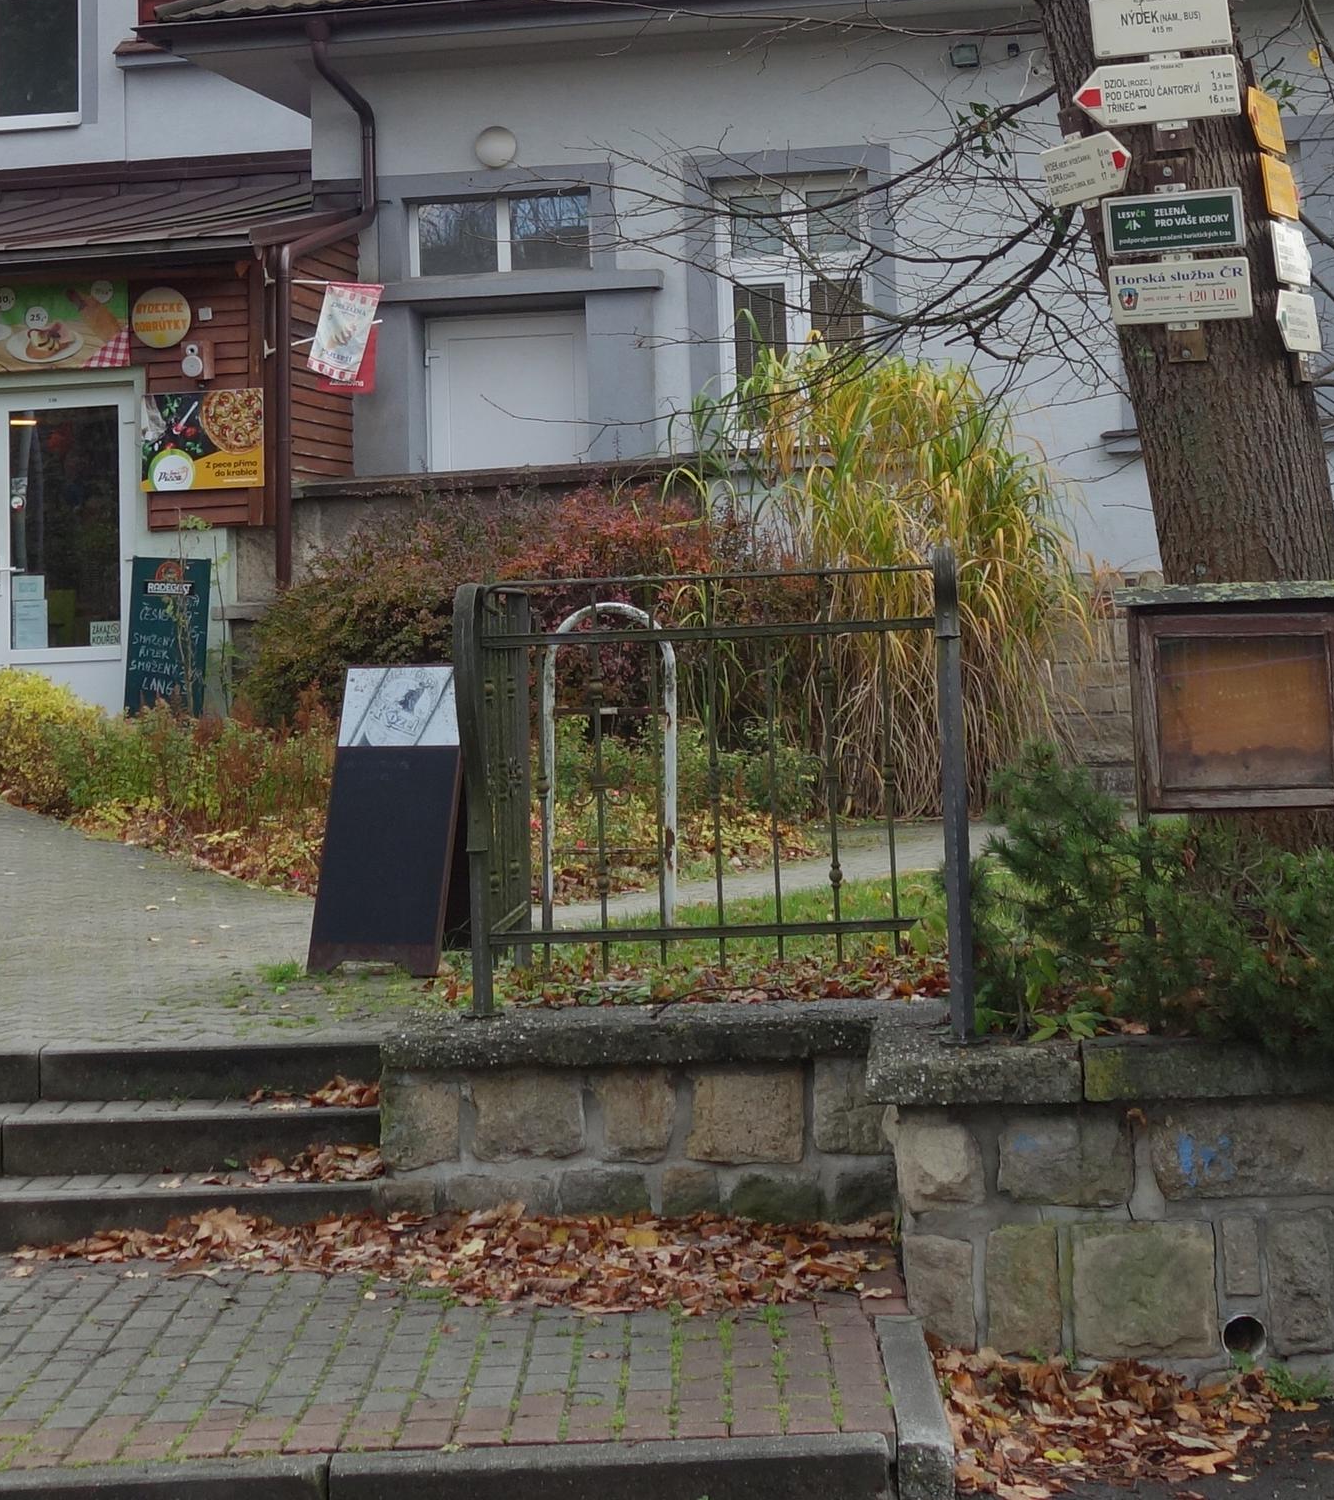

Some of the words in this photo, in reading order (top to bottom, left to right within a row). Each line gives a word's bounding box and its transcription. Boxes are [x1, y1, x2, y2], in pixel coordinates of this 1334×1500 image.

[1120, 10, 1160, 27] NÝDEK
[1184, 11, 1202, 21] BUS)
[1152, 26, 1165, 34] 415
[1222, 71, 1233, 79] km
[1104, 79, 1127, 90] DZIOL
[1224, 83, 1235, 91] km
[1105, 92, 1122, 101] POD
[1123, 88, 1156, 100] CHATOU
[1157, 81, 1201, 97] ČANTORYJÍ
[1107, 102, 1136, 114] TŘINEC
[1154, 204, 1187, 217] ZELENÁ
[1155, 219, 1174, 228] PRO
[1174, 214, 1198, 227] VAŠE
[1199, 213, 1230, 224] KROKY
[1119, 236, 1159, 246] podporujeme
[1183, 229, 1219, 240] turistických
[1219, 229, 1232, 237] tras
[1115, 272, 1166, 286] Horská
[1170, 269, 1215, 281] služba
[1219, 265, 1244, 279] ČR
[206, 461, 211, 469] Z
[213, 461, 232, 470] pece
[234, 459, 258, 470] přímo
[227, 468, 258, 476] krabice
